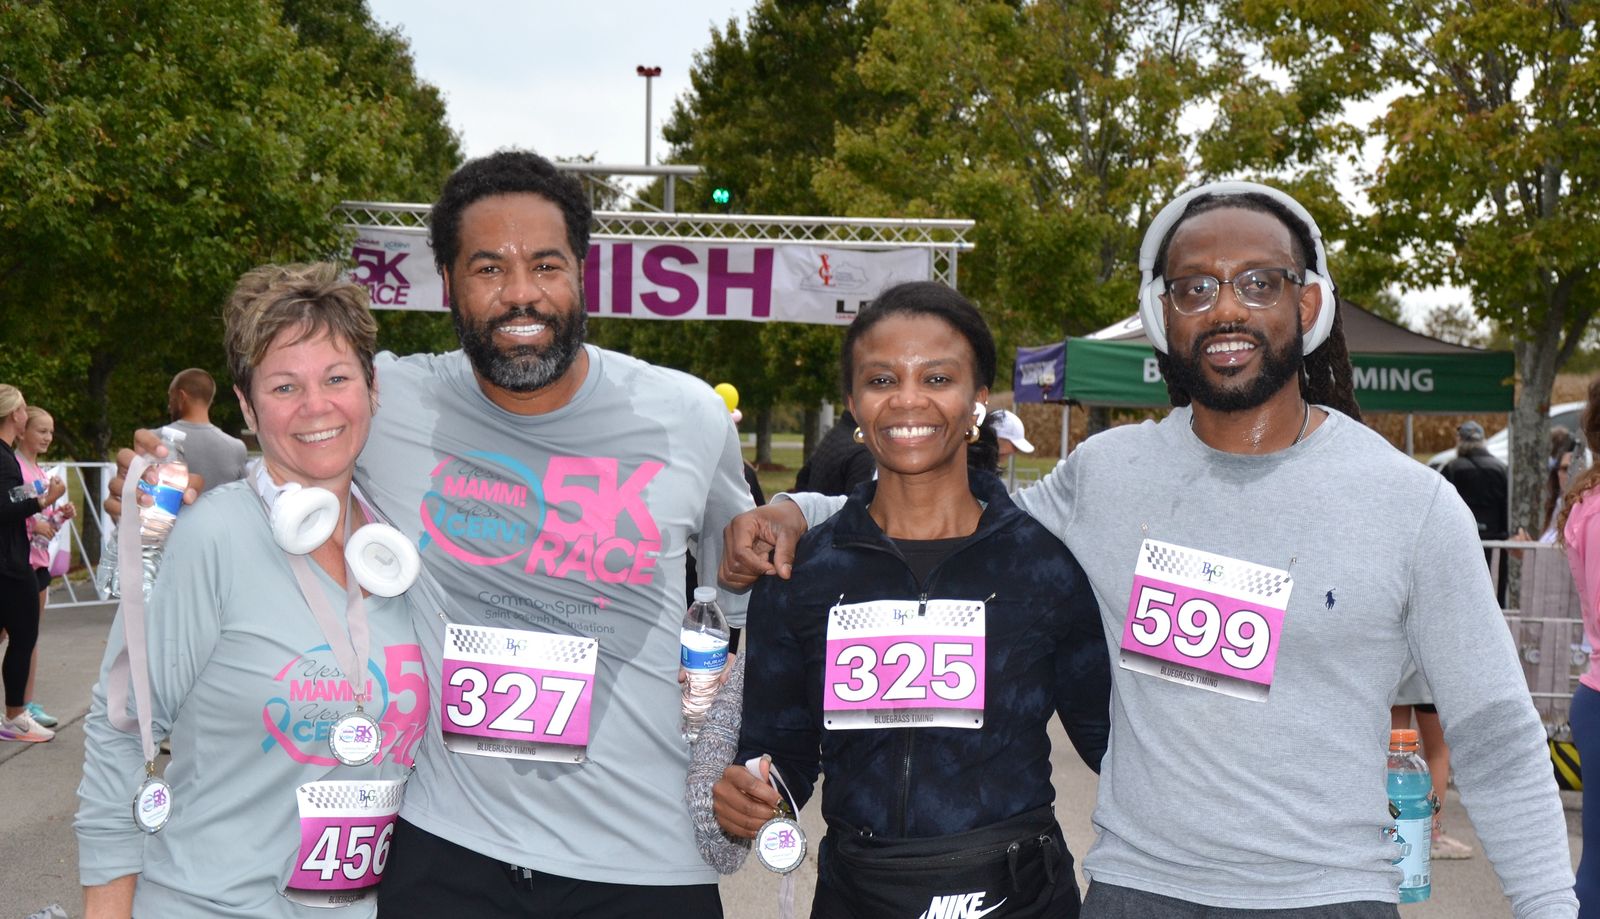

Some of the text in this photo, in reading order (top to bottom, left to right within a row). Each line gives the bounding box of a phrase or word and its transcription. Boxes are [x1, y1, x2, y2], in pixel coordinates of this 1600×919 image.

[352, 247, 411, 285] 5K
[443, 476, 528, 509] MAMM!
[542, 456, 665, 546] 5K
[446, 513, 527, 545] CERV!
[524, 533, 661, 586] RACE
[1131, 584, 1271, 671] 599
[832, 641, 977, 703] 325
[1160, 666, 1219, 688] BLUEGRASS TIMING
[446, 667, 588, 737] 327
[874, 713, 934, 724] BLUEGRASS TIMING
[477, 742, 536, 756] BLUEGRASS TIMING
[301, 822, 394, 881] 456
[926, 891, 987, 919] NIKE
